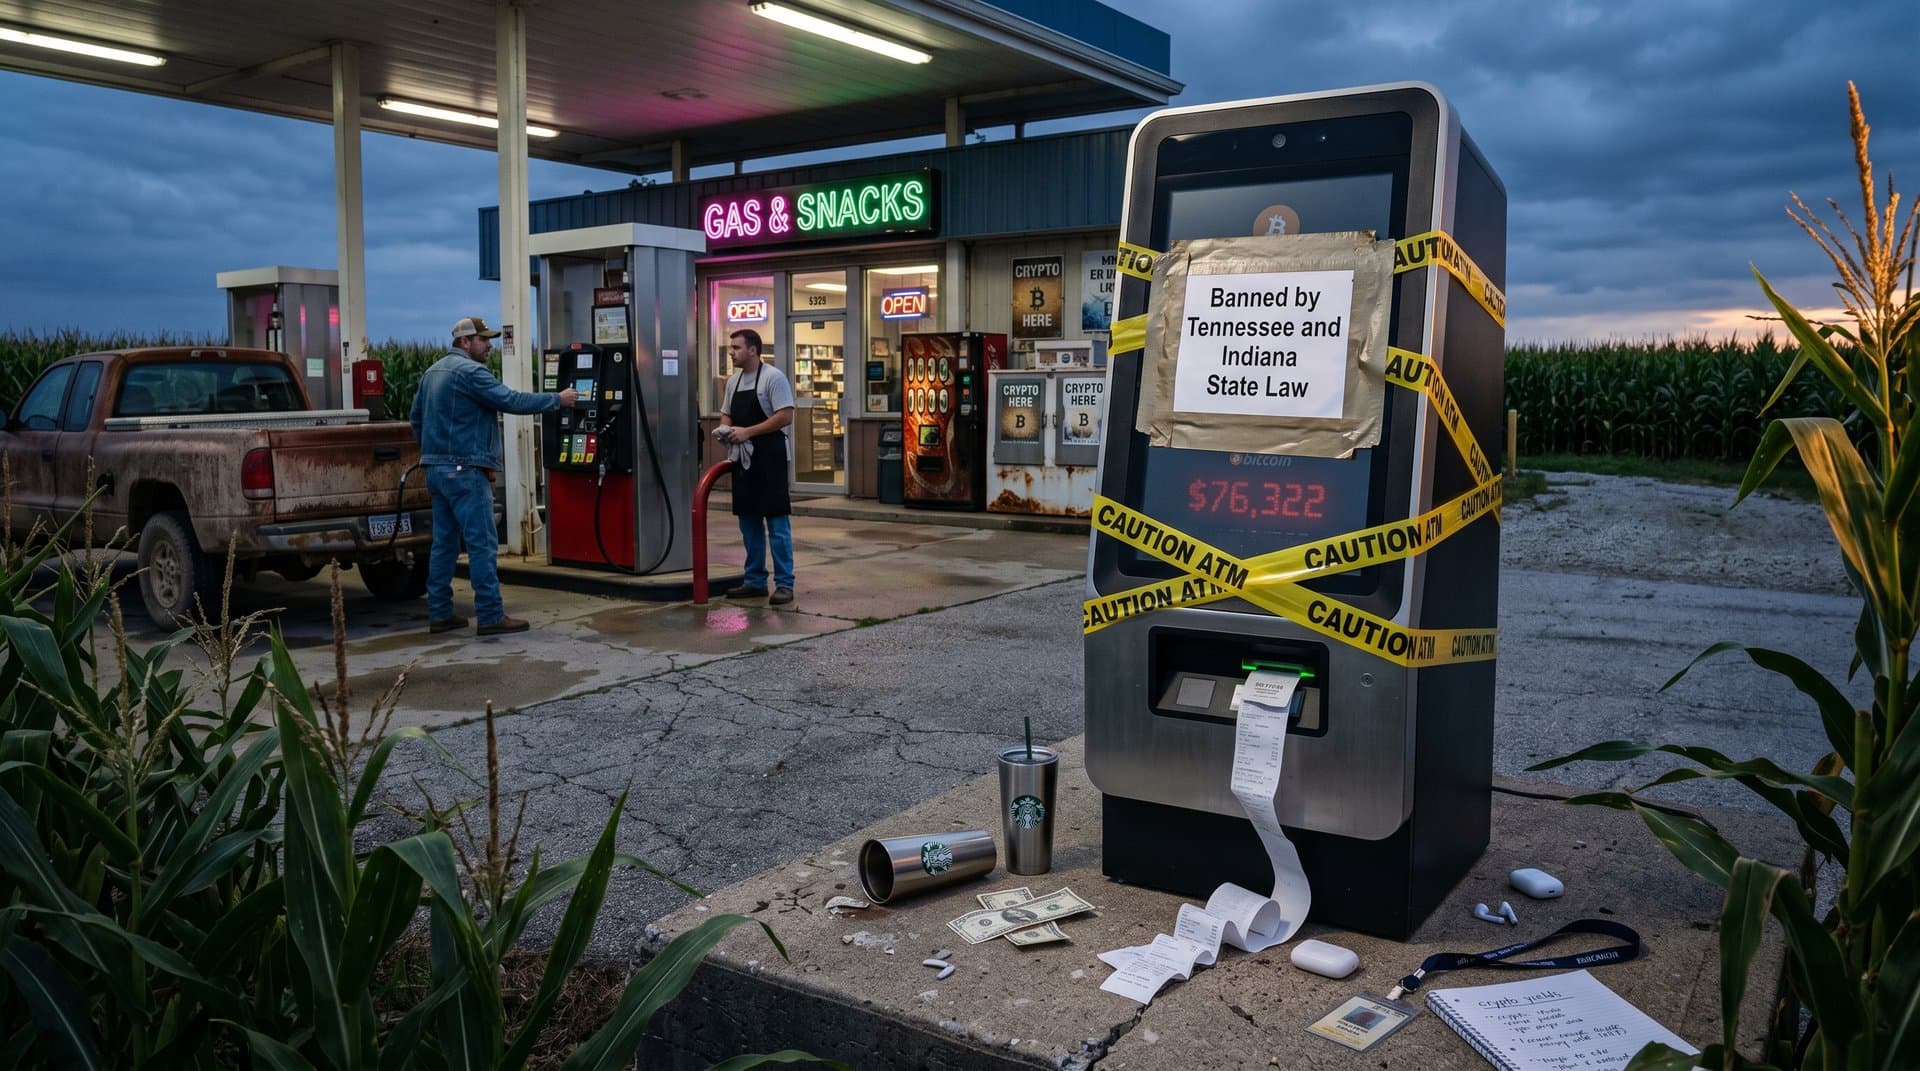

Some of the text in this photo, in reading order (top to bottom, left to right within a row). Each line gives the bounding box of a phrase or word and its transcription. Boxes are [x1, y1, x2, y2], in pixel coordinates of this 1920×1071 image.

[704, 180, 924, 239] GAS & SNACKS
[1015, 263, 1060, 278] CRYPTO
[1117, 247, 1154, 275] TIO
[882, 294, 926, 316] OPEN
[1210, 286, 1321, 312] Banned by
[728, 302, 766, 319] OPEN
[1022, 313, 1053, 327] HERE
[1187, 316, 1341, 337] Tennessee and
[1222, 345, 1297, 367] Indiana
[1003, 384, 1039, 396] CRYPTO
[1065, 383, 1104, 394] CRYPTO
[1206, 374, 1309, 398] State Law
[1008, 397, 1033, 408] HERE
[1071, 395, 1096, 406] HERE
[1188, 479, 1326, 519] $76,322
[1098, 505, 1249, 590] CAUTION ATM
[1304, 523, 1422, 571] CAUTION
[1425, 512, 1442, 544] ATM
[1307, 600, 1418, 660] CAUTION
[1418, 635, 1435, 660] ATM
[1452, 635, 1481, 657] CAUTION
[1478, 990, 1562, 1009] crypto yields
